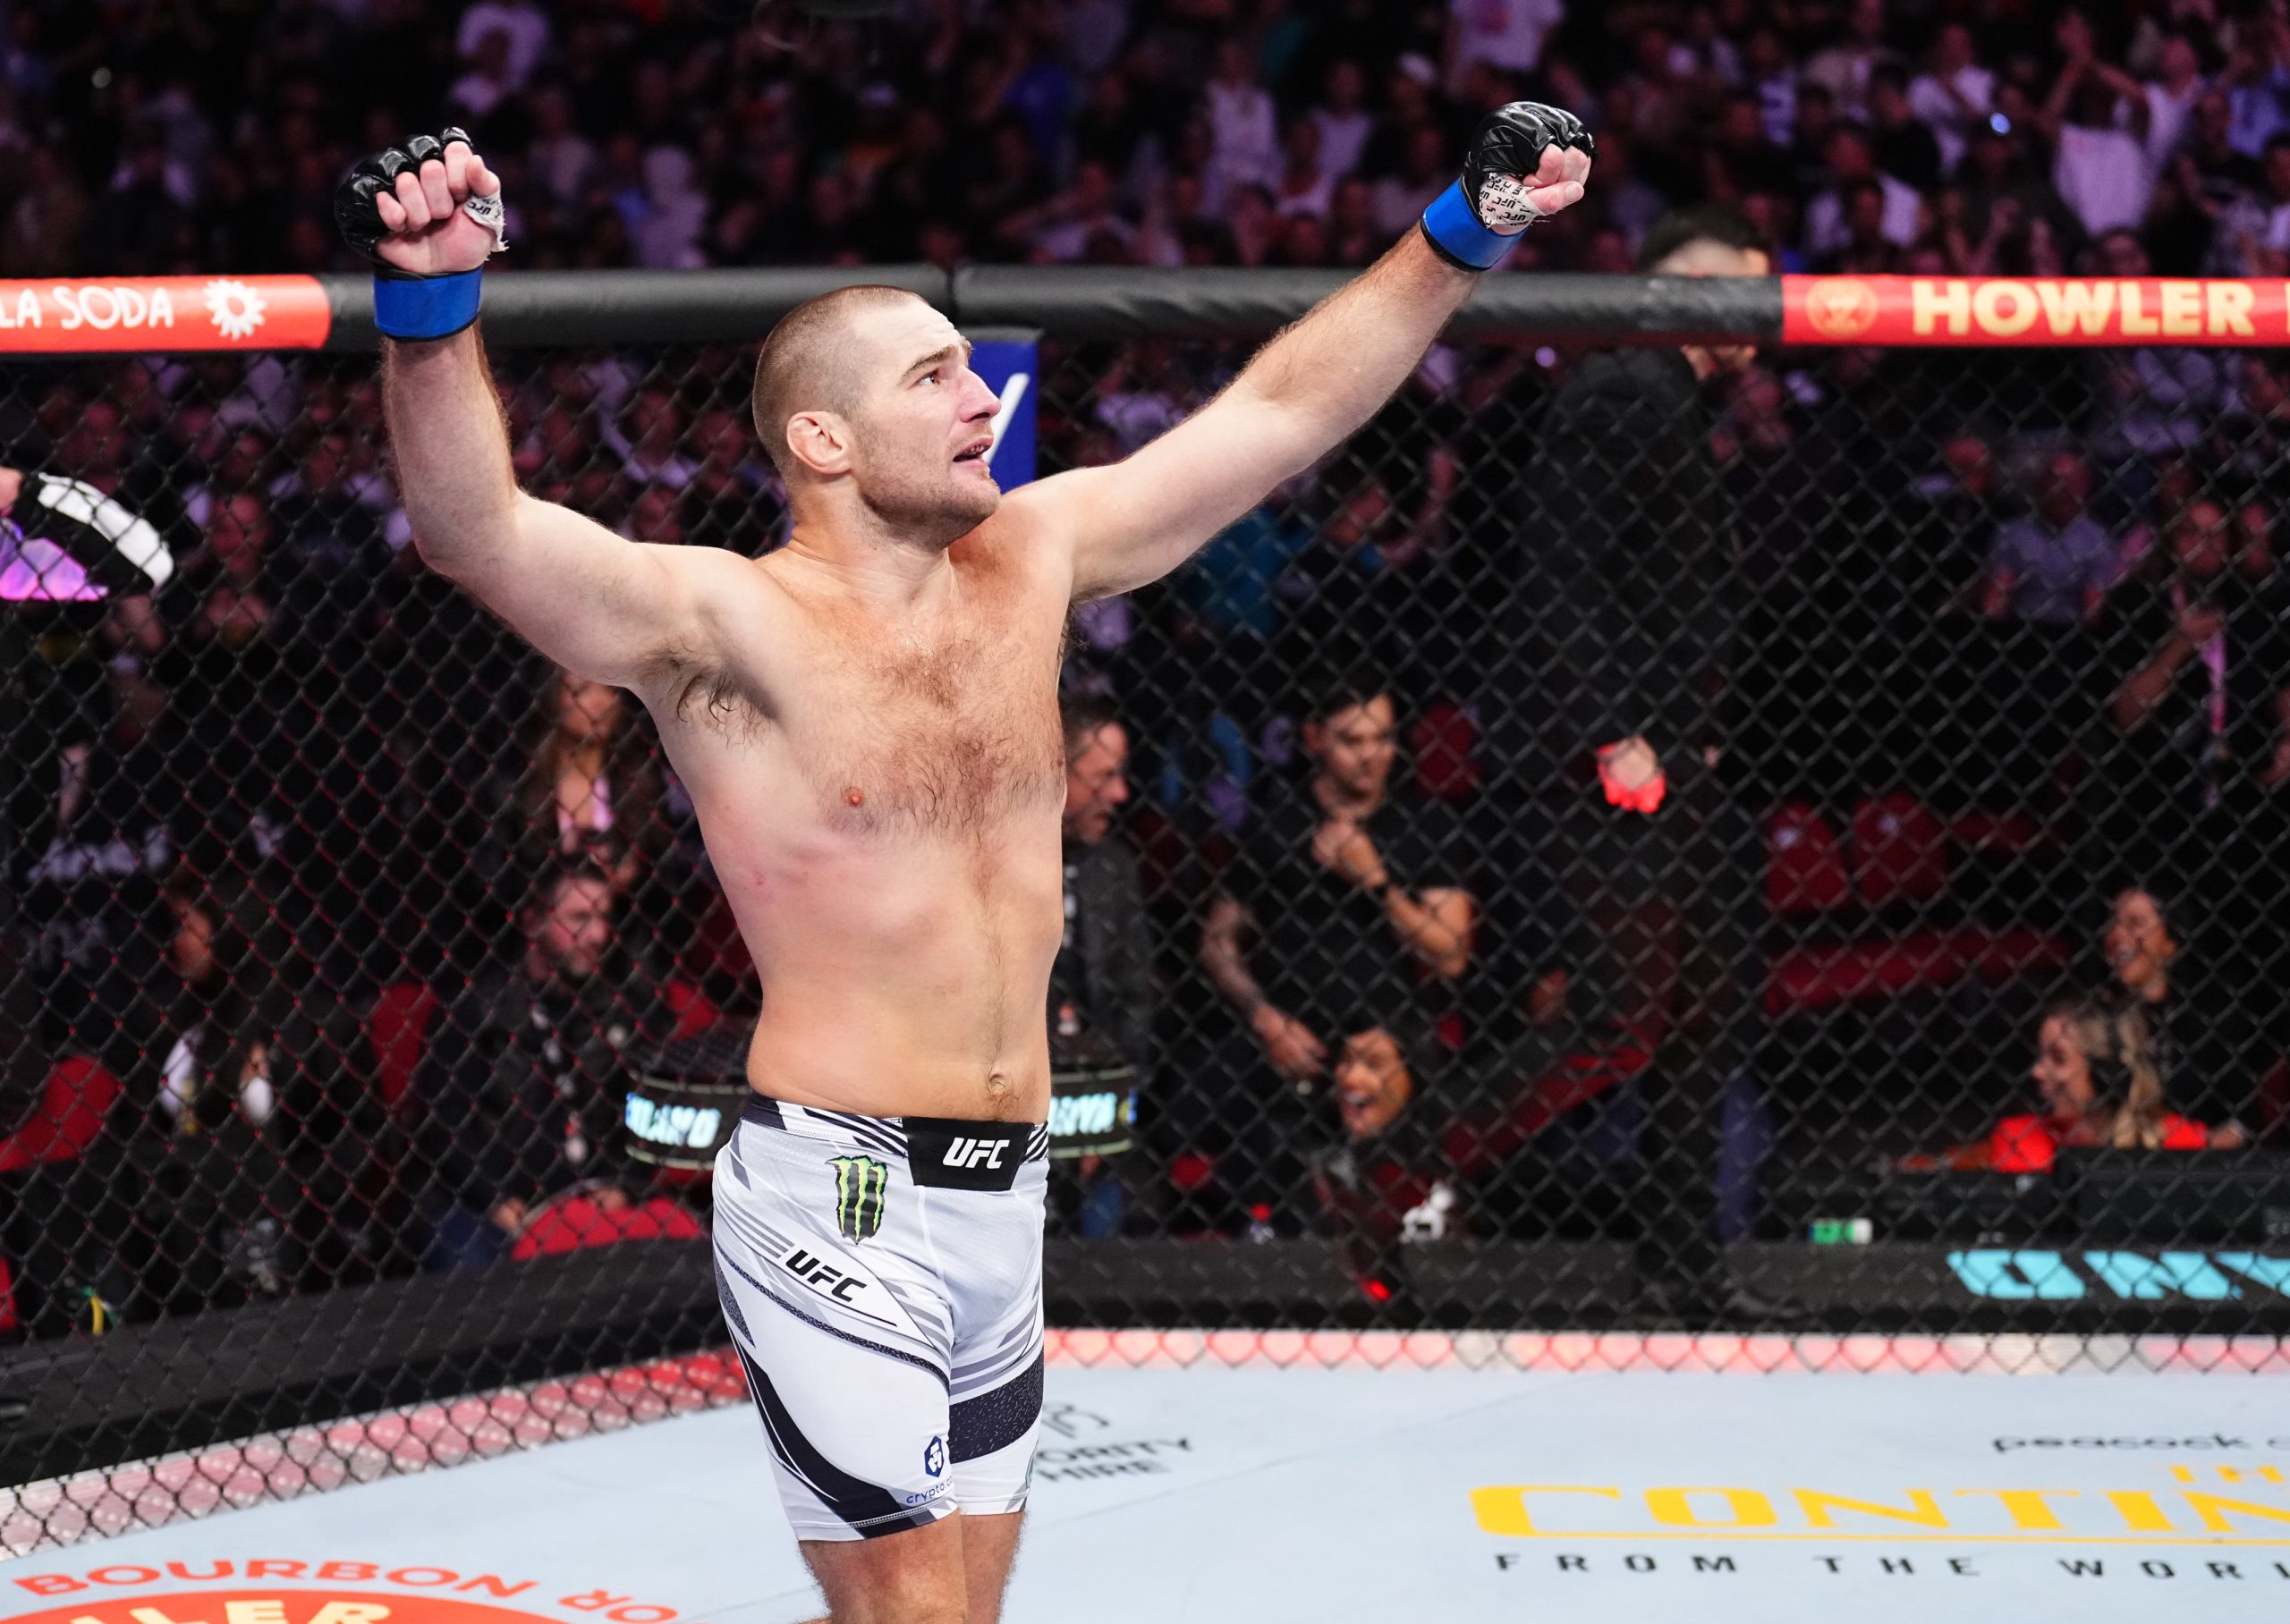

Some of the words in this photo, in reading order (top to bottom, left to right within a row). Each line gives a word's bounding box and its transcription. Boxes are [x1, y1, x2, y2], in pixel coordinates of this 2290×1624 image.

[1491, 196, 1516, 208] UFC
[1503, 211, 1526, 221] UFC
[52, 285, 174, 330] SODA
[1911, 281, 2255, 335] HOWLER
[942, 1137, 1010, 1170] UFC
[785, 1248, 868, 1302] UFC
[1992, 1433, 2252, 1453] peacock
[12, 1559, 539, 1597] BOURBON
[1495, 1554, 1737, 1573] FROM
[1814, 1555, 1980, 1577] THE
